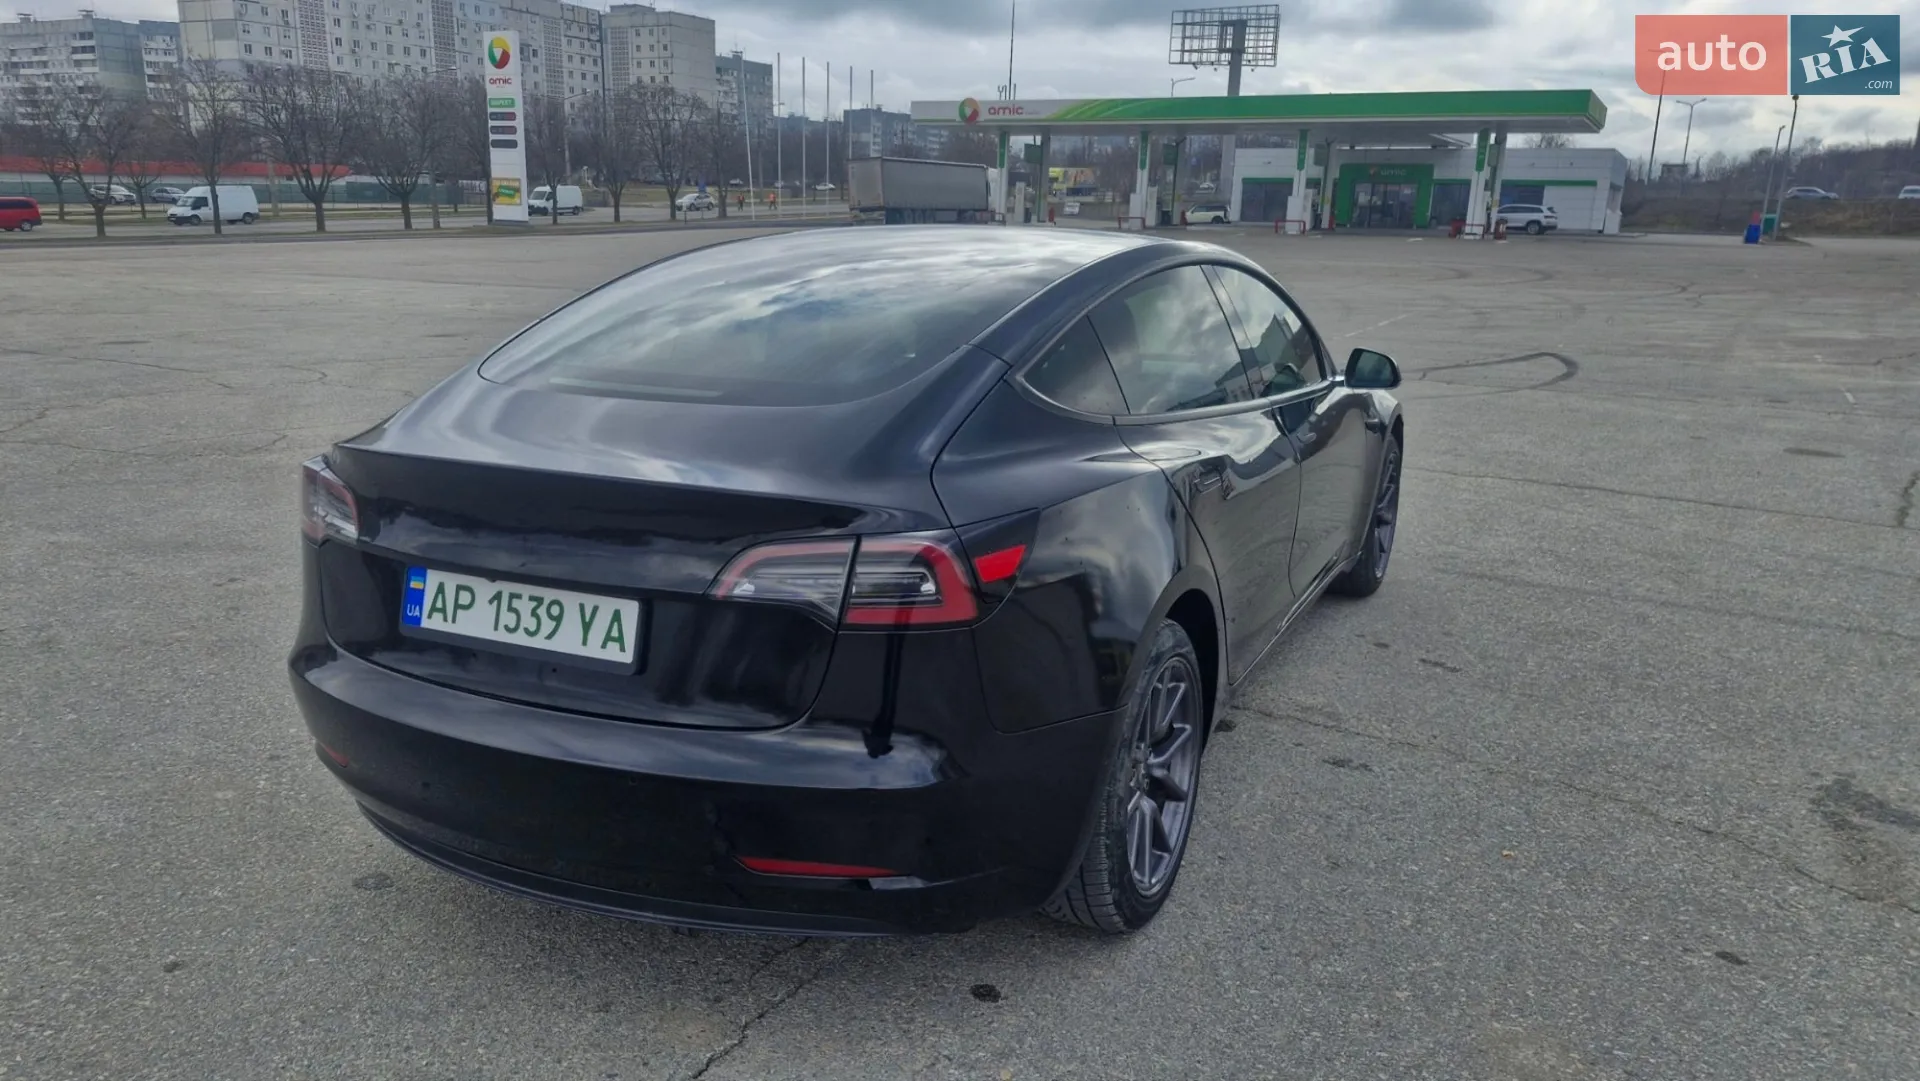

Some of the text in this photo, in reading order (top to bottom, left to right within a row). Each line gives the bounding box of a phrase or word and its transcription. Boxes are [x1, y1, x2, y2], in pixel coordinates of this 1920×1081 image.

[489, 76, 512, 86] amic
[988, 104, 1025, 116] amic
[406, 603, 421, 618] UA
[427, 581, 627, 653] AP 1539 YA
